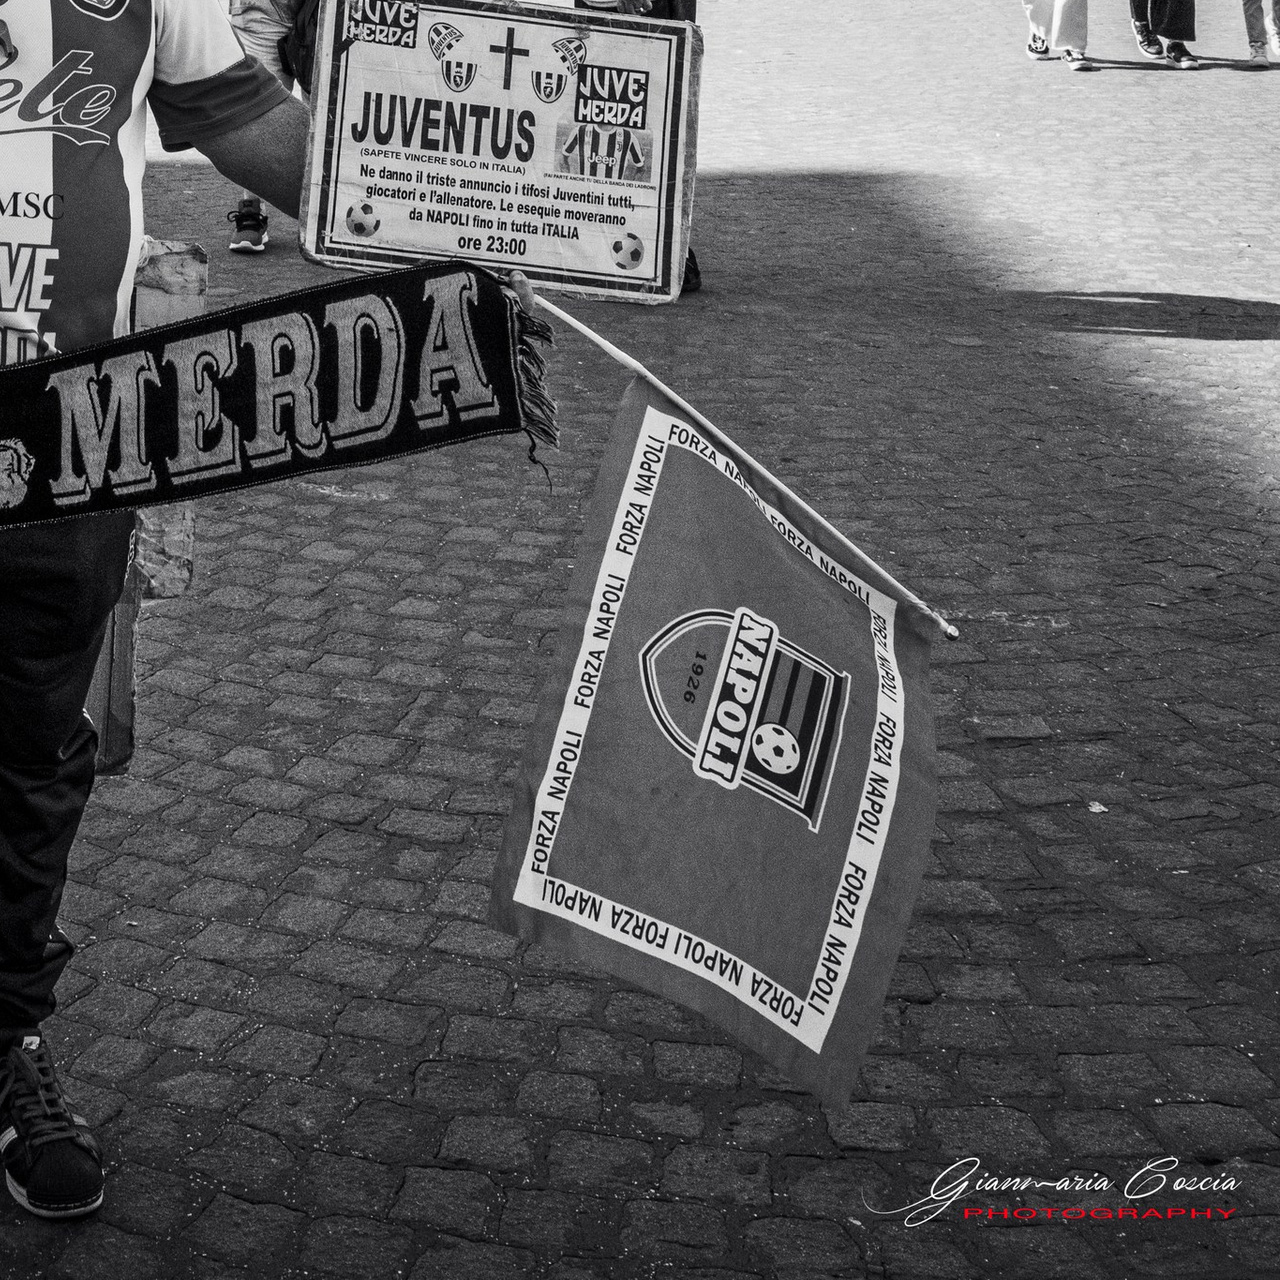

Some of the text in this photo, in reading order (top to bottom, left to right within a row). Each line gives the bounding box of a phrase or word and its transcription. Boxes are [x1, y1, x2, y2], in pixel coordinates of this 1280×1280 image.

[347, 21, 415, 48] MERDA
[433, 29, 458, 54] JUVENTUS
[558, 40, 580, 71] JUVENTUS
[579, 67, 646, 103] JUVE
[351, 91, 535, 162] JUVENTUS
[578, 98, 644, 127] MERDA
[360, 148, 526, 176] (SAPETE VINCERE SOLO IN ITALIA)
[587, 152, 617, 167] Jeep
[360, 164, 635, 212] Ne danno il triste annuncio i tifosi Juventini tutti,
[366, 185, 416, 201] giocatori
[419, 192, 426, 202] e
[500, 198, 514, 212] Le
[517, 202, 561, 219] esequie
[564, 209, 626, 226] moveranno
[409, 208, 580, 240] da NAPOLI fino in tutta ITALIA
[458, 235, 527, 256] ore 23:00
[45, 271, 500, 506] MERDA
[668, 424, 718, 465] FORZA
[770, 514, 814, 560] FORZA
[820, 556, 871, 606] NAPOLI
[532, 435, 665, 874] FORZA NAPOLI FORZA NAPOLI FORZA NAPOLI
[683, 650, 707, 704] 1926
[700, 613, 772, 781] NAPOLI
[873, 711, 897, 767] FORZA
[856, 771, 890, 845] NAPOLI
[833, 861, 867, 929] FORZA
[542, 878, 805, 1027] FORZA NAPOLI FORZA NAPOLI
[808, 934, 847, 1016] NAPOLI
